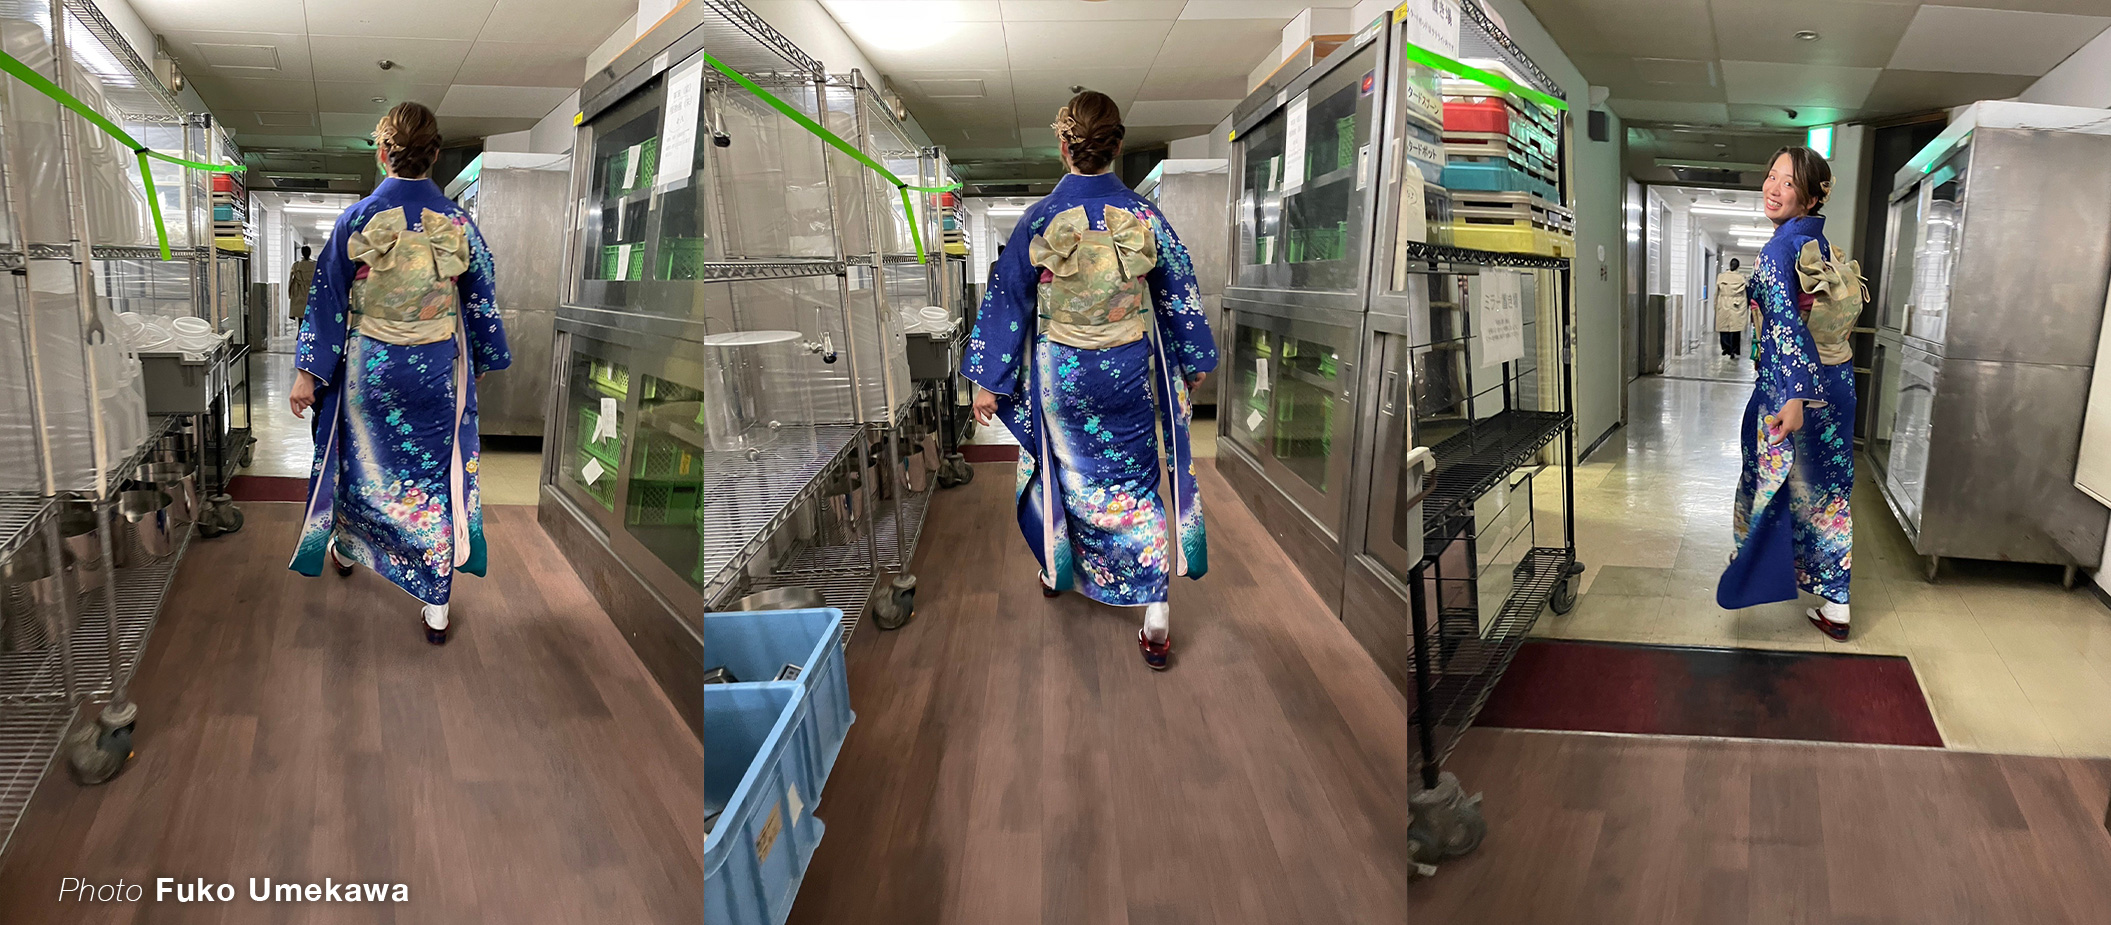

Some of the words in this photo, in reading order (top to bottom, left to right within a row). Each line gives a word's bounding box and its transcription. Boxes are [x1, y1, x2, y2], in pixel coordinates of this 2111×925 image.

[1406, 140, 1437, 160] タードポット
